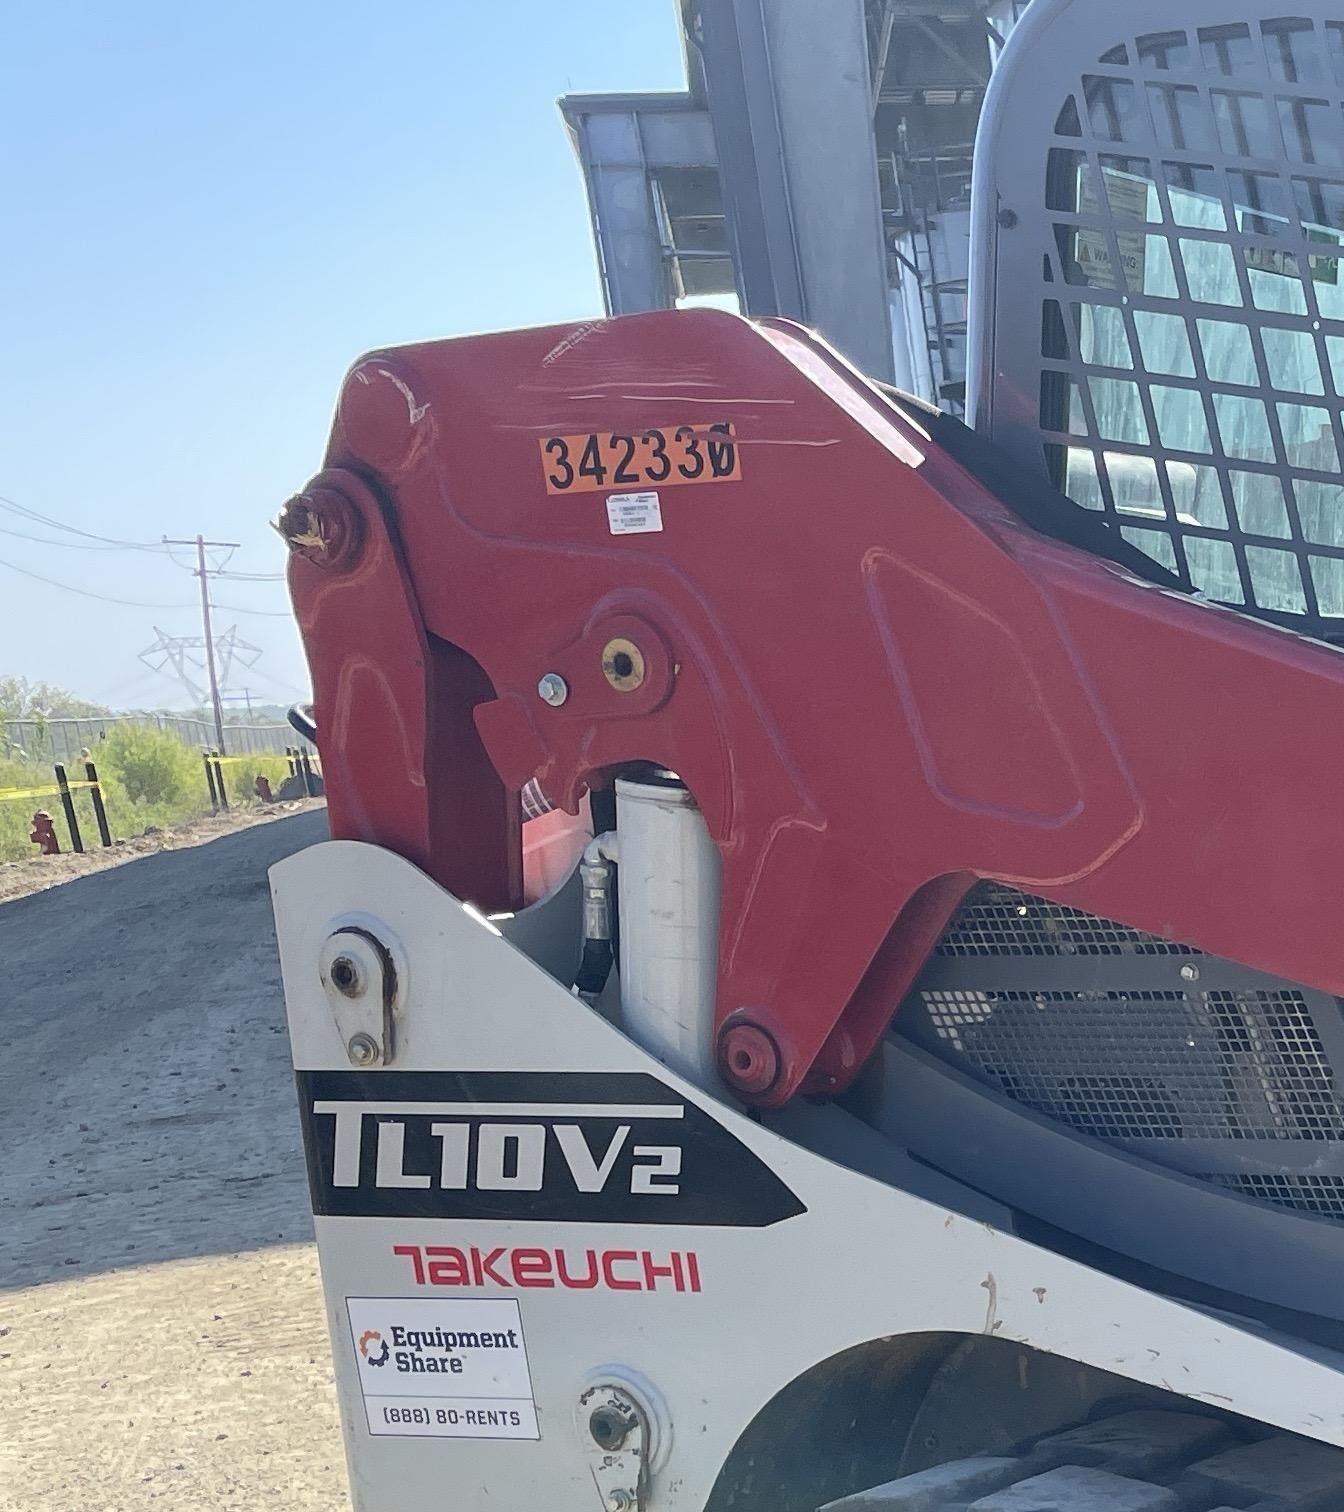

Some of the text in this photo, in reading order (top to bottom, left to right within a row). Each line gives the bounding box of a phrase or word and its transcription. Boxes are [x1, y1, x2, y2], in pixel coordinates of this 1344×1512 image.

[545, 423, 735, 489] 342330
[313, 1101, 684, 1195] TL10V2
[393, 1245, 702, 1293] TAKEUCHI
[390, 1326, 519, 1352] Equipment
[395, 1352, 463, 1374] Share
[383, 1406, 521, 1426] (888) 80-RENTS
